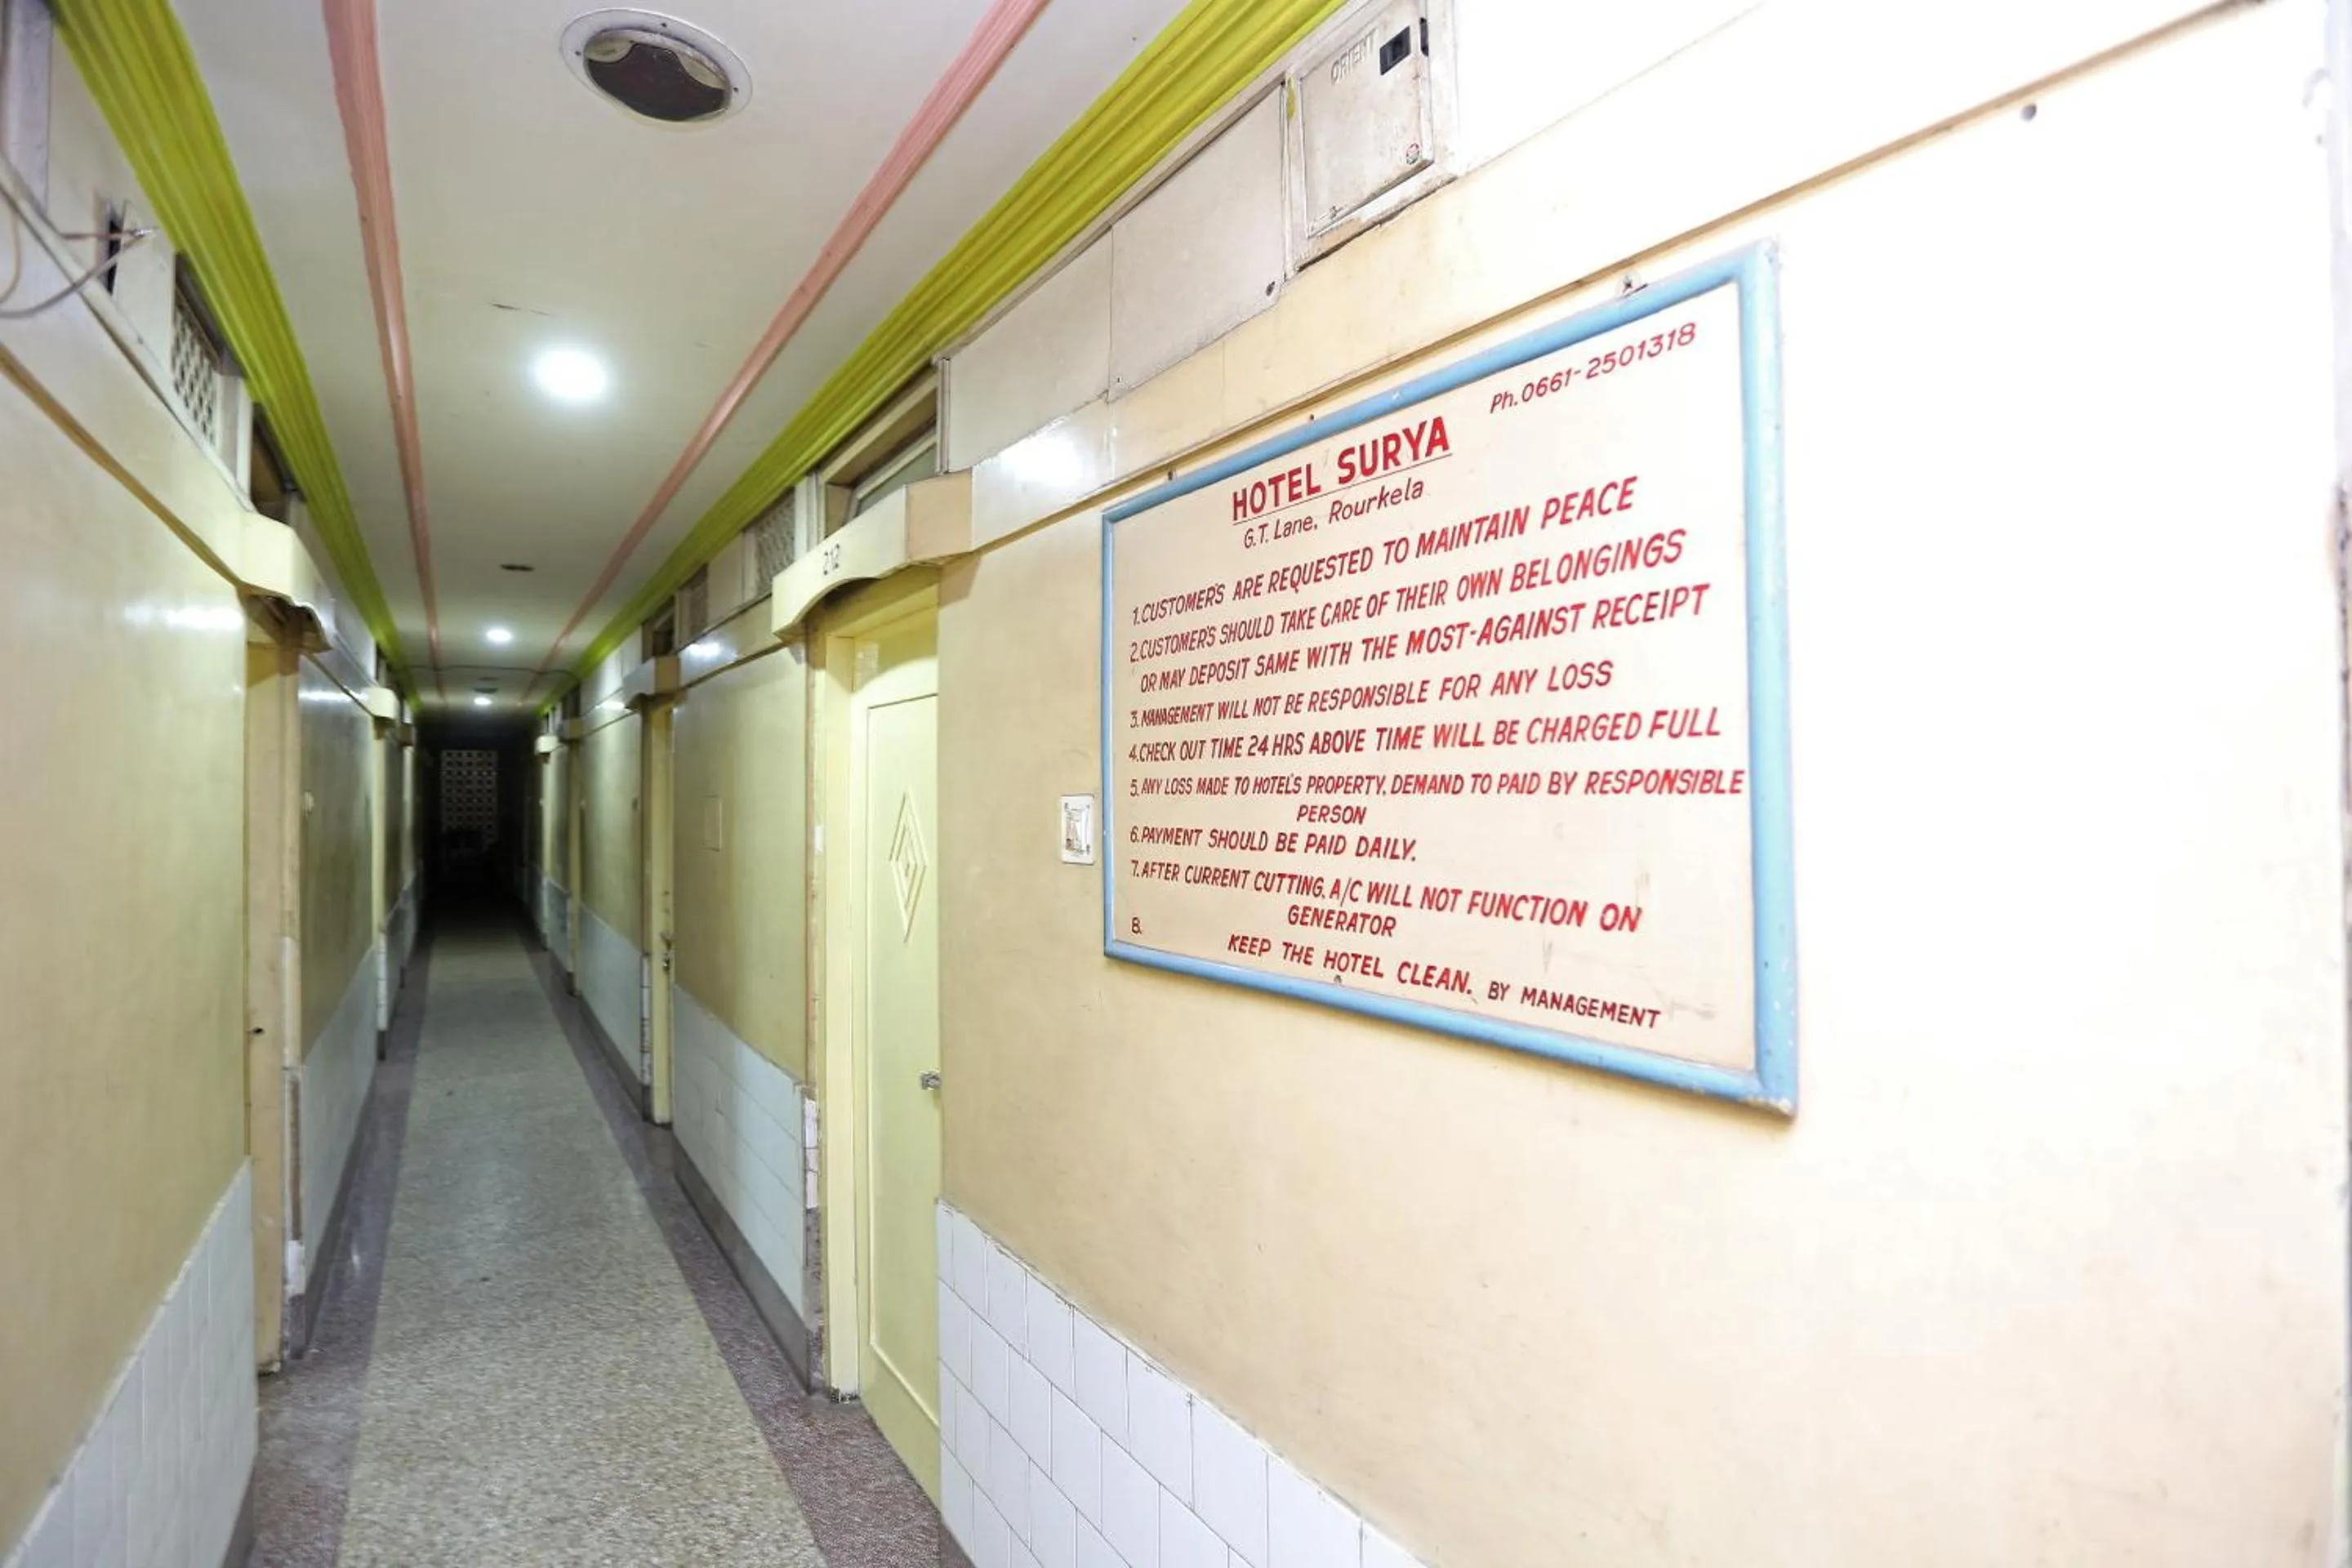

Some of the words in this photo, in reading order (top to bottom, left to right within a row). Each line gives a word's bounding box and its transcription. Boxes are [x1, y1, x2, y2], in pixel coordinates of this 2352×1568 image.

[1232, 463, 1321, 521] HOTEL
[1338, 416, 1450, 484] SURYA
[1329, 478, 1424, 524] Rourkela
[1232, 573, 1265, 601] ARE
[1267, 546, 1374, 595] REQUESTED
[1383, 537, 1410, 566] TO
[1415, 506, 1531, 559] MAINTAIN
[1540, 475, 1638, 530] PEACE
[1219, 614, 1275, 645] SHOULD
[1280, 605, 1317, 634] TAKE
[1321, 596, 1364, 627] CARE
[1366, 590, 1391, 618] OF
[1396, 579, 1449, 613] THEIR
[1456, 568, 1503, 602] OWN
[1509, 528, 1688, 593] BELONGINGS
[1140, 674, 1158, 693] OR
[1159, 668, 1187, 690] MAY
[1188, 657, 1251, 687] DEPOSIT
[1254, 649, 1301, 676] SAME
[1307, 641, 1353, 670] WITH
[1361, 633, 1399, 662] THE
[1592, 583, 1712, 630] RECEIPT
[1217, 699, 1250, 720] WILL
[1253, 695, 1282, 717] NOT
[1284, 693, 1306, 715] BE
[1307, 679, 1430, 713] RESPONSIBLE
[1439, 673, 1481, 701] FOR
[1490, 668, 1539, 697] ANY
[1547, 660, 1615, 693] LOSS
[1179, 739, 1206, 761] OUT
[1210, 736, 1245, 760] TIME
[1247, 735, 1269, 757] 24
[1272, 732, 1306, 756] HRS
[1308, 728, 1367, 755] ABOVE
[1375, 724, 1426, 752] TIME
[1432, 722, 1486, 748] WILL
[1492, 719, 1521, 746] BE
[1526, 712, 1642, 744] CHARGED
[1647, 706, 1722, 740] FULL
[1164, 777, 1193, 795] LOSS
[1196, 777, 1230, 795] MADE
[1234, 776, 1250, 795] TO
[1390, 773, 1465, 795] DEMAND
[1470, 773, 1492, 795] TO
[1496, 772, 1542, 794] PAID
[1550, 770, 1579, 795] BY
[1584, 768, 1745, 795] RESPONSIBLE
[1296, 804, 1368, 826] PERSON
[1208, 829, 1268, 852] SHOULD
[1274, 831, 1299, 853] BE
[1304, 833, 1347, 856] PAID
[1355, 835, 1417, 862] DAILY.
[1130, 916, 1143, 935] 8.
[1184, 864, 1250, 889] CURRENT
[1329, 877, 1363, 906] A/C
[1367, 881, 1412, 908] WILL
[1420, 886, 1462, 912] NOT
[1468, 890, 1588, 928] FUNCTION
[1599, 902, 1643, 933] ON
[1287, 904, 1397, 938] GENERATOR
[1227, 933, 1272, 957] KEEP
[1281, 942, 1315, 966] THE
[1323, 950, 1385, 978] HOTEL
[1397, 960, 1472, 996] CLEAN.
[1488, 980, 1511, 1001] BY
[1521, 986, 1661, 1029] MANAGEMENT
